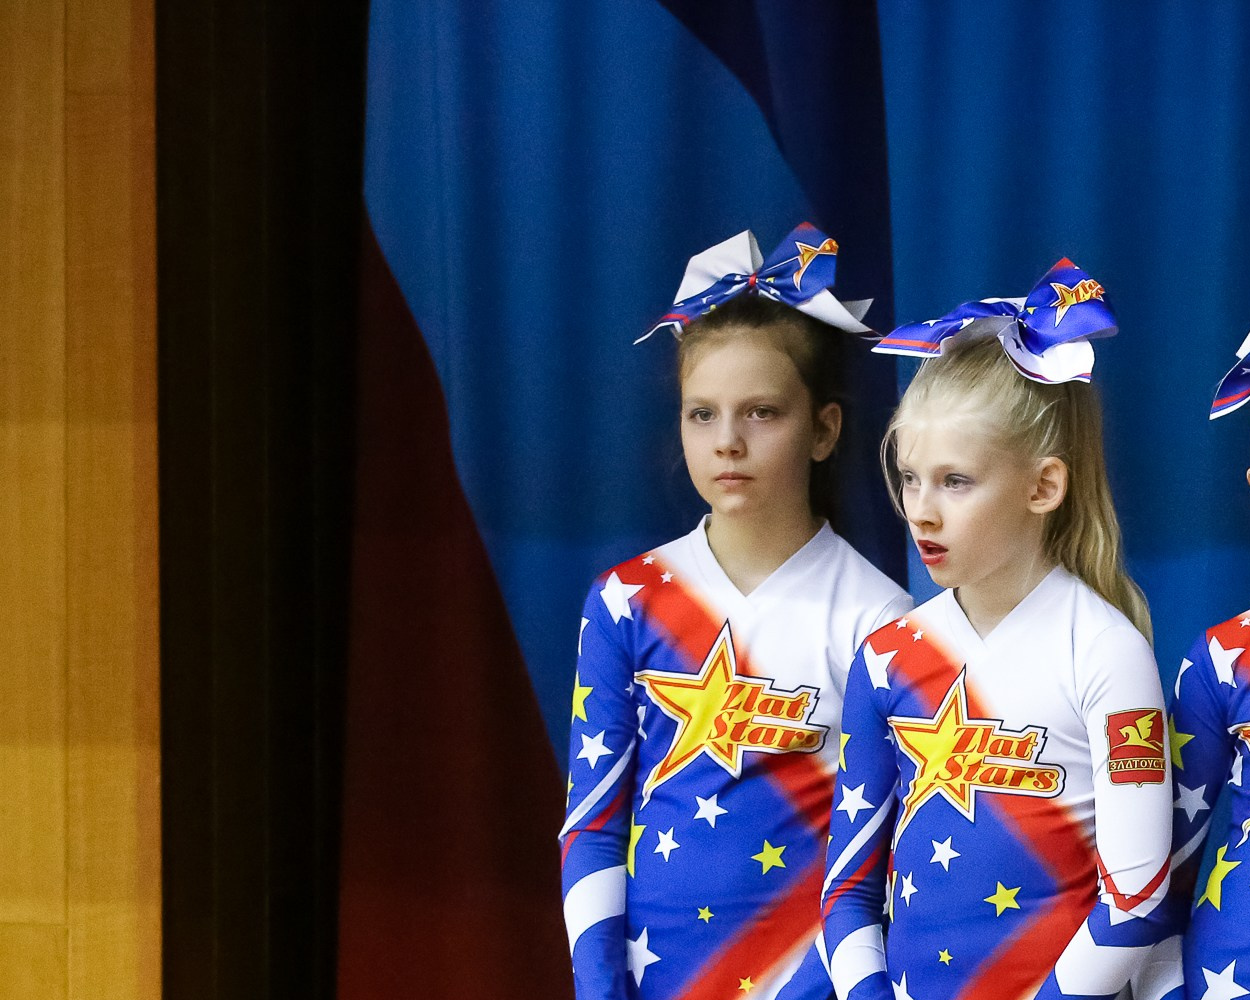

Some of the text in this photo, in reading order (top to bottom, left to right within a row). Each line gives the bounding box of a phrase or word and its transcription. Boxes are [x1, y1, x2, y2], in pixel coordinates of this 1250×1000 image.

[721, 683, 808, 719] Zlat
[707, 711, 820, 748] Stars
[952, 727, 1036, 758] Zlat
[934, 754, 1056, 789] Stars
